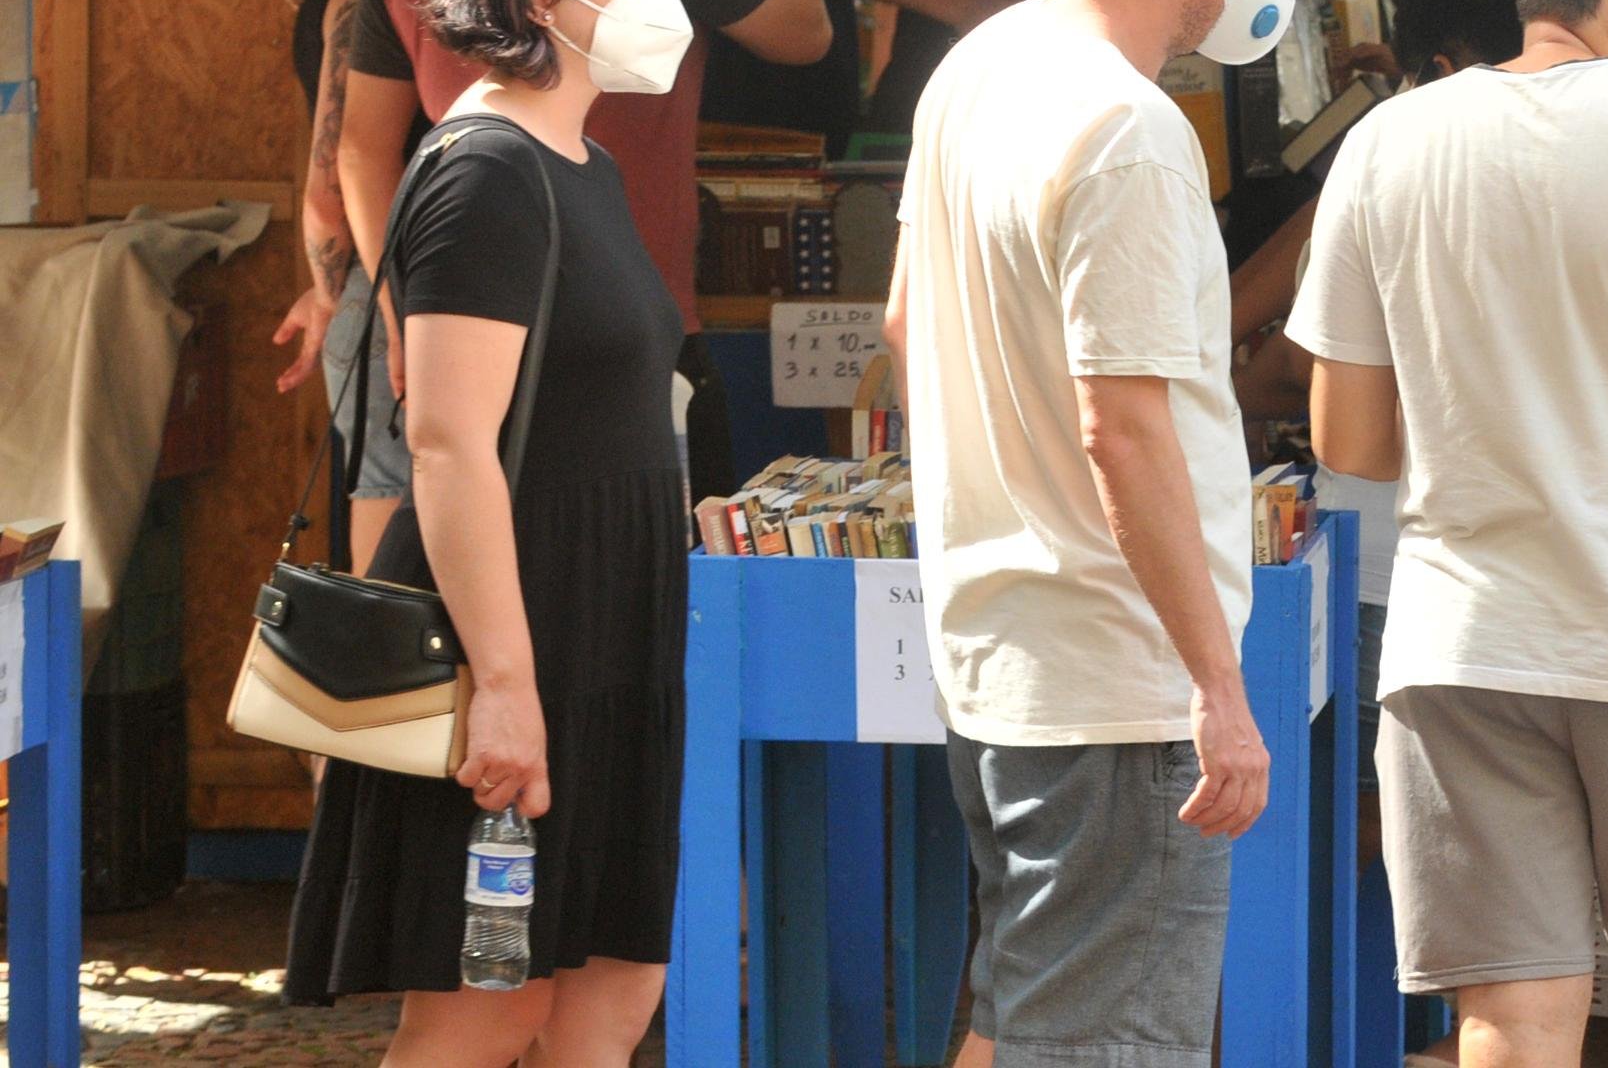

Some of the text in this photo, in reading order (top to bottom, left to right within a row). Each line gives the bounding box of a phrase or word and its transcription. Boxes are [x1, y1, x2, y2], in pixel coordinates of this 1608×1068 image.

[786, 333, 797, 351] 1
[784, 361, 798, 380] 3
[896, 638, 904, 656] 1
[894, 664, 905, 681] 3
